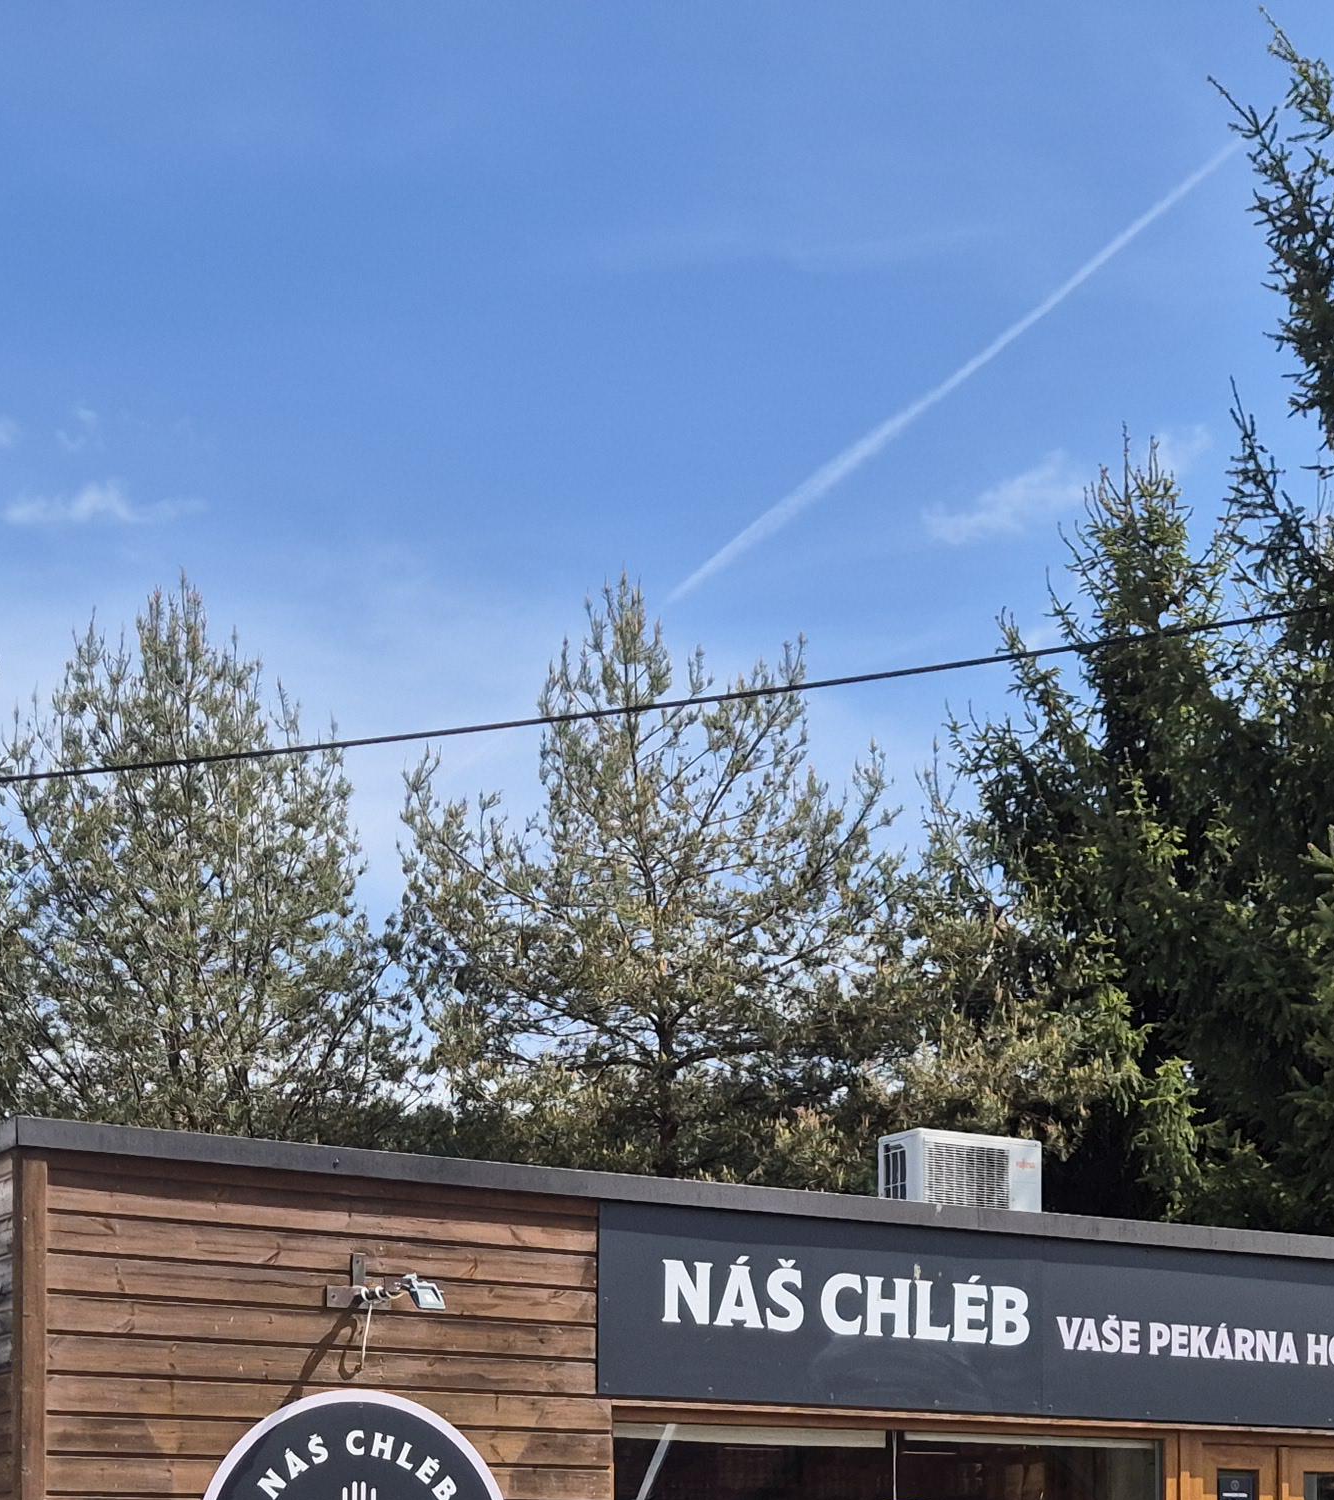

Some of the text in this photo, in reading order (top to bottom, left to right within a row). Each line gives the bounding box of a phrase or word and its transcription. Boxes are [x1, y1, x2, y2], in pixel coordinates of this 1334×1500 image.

[661, 1255, 804, 1333] NÁŠ
[820, 1273, 1031, 1346] CHLÉB
[1056, 1314, 1141, 1355] VAŠE
[1148, 1321, 1299, 1364] PEKÁRNA
[257, 1433, 329, 1500] NÁŠ
